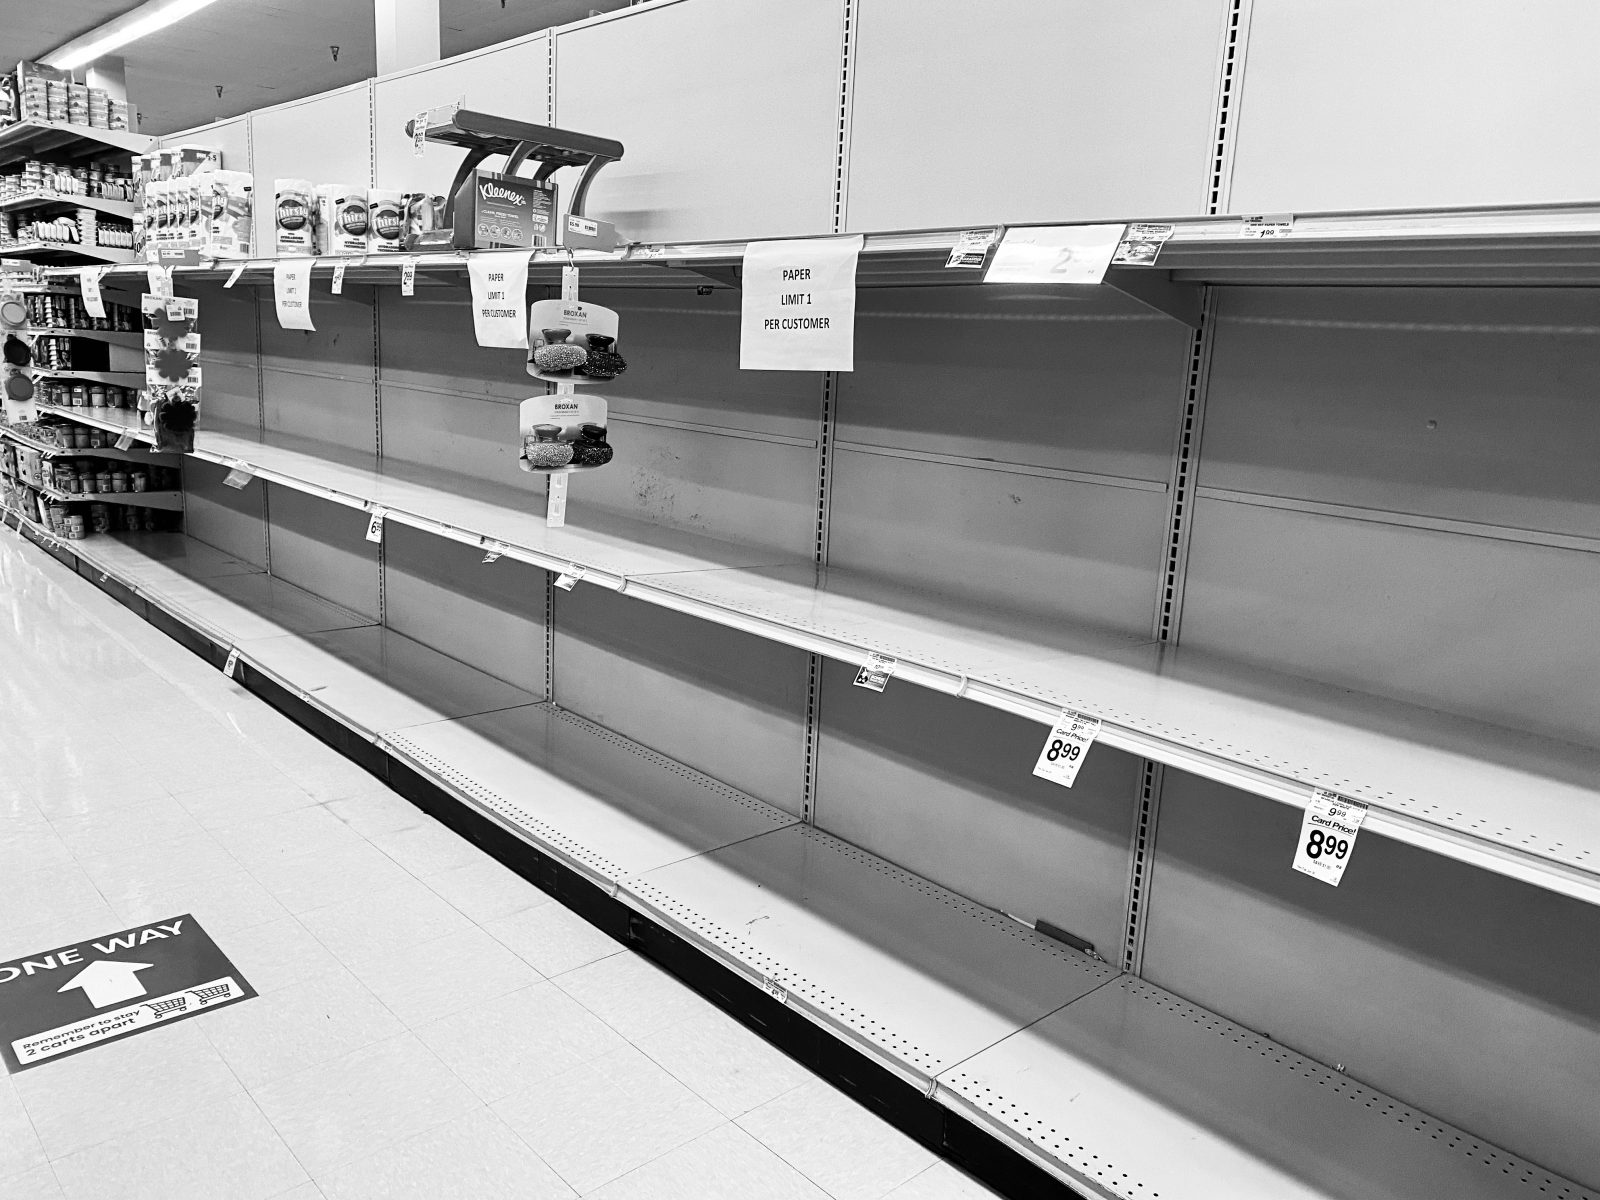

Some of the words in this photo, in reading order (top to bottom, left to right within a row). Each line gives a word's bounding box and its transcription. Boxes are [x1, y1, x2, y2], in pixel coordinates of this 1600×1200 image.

[479, 183, 523, 206] Kleenex
[488, 273, 504, 281] PAPER
[782, 269, 811, 281] PAPER
[487, 291, 501, 300] LIMIT
[781, 294, 804, 305] LIMIT
[807, 293, 812, 305] 1
[481, 309, 490, 318] PER
[490, 309, 517, 318] CUSTOMER
[563, 309, 587, 318] BROXAN
[764, 319, 780, 330] PER
[782, 318, 830, 329] CUSTOMER
[1056, 728, 1071, 737] Card
[1311, 815, 1332, 826] Card
[1332, 822, 1357, 835] Price!
[1306, 829, 1348, 860] 899
[0, 948, 84, 984] ONE
[92, 920, 183, 954] WAY
[23, 1023, 95, 1049] Remember
[113, 1010, 140, 1020] stay
[41, 1034, 85, 1052] carts
[89, 1018, 136, 1035] apart
